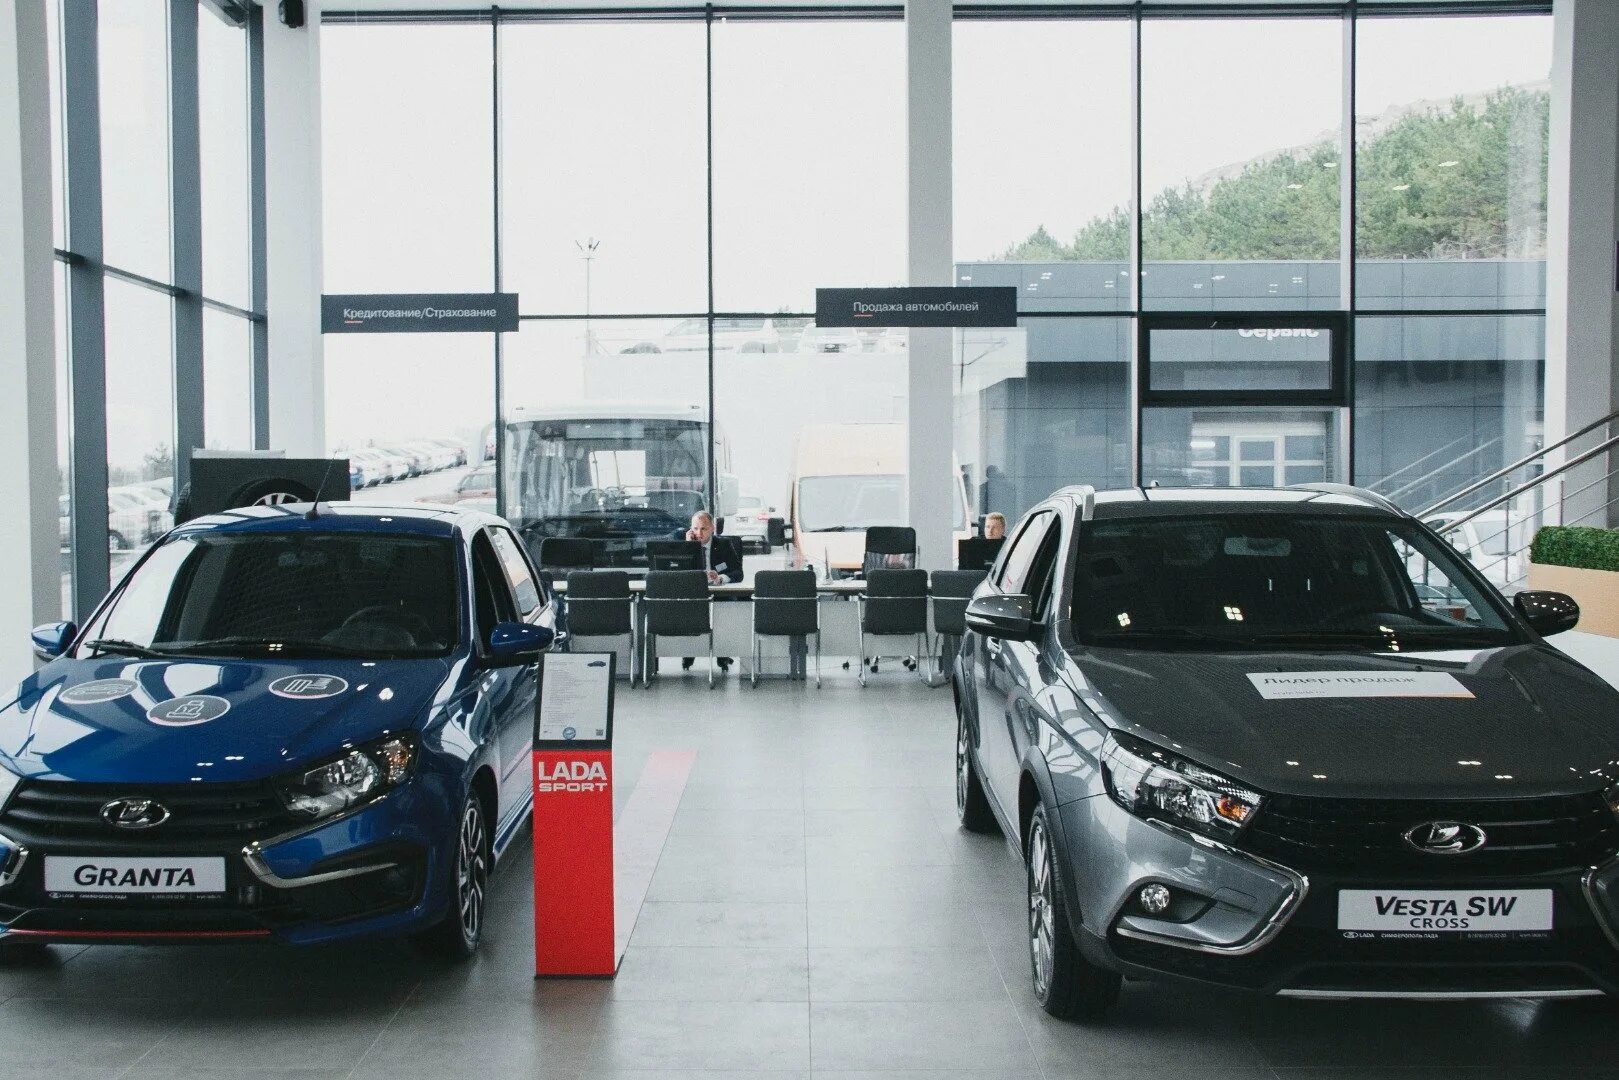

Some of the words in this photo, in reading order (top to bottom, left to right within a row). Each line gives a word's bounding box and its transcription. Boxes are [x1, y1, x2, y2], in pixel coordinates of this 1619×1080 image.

[343, 307, 497, 320] Кредитование/Страхование
[853, 302, 903, 314] Продажа
[905, 301, 979, 312] автомобилей
[1263, 677, 1331, 685] Лидер
[1336, 676, 1416, 684] продаж
[538, 761, 607, 781] LADA
[538, 782, 608, 792] SPORT
[1466, 895, 1518, 917] SW
[1409, 917, 1470, 929] CROSS
